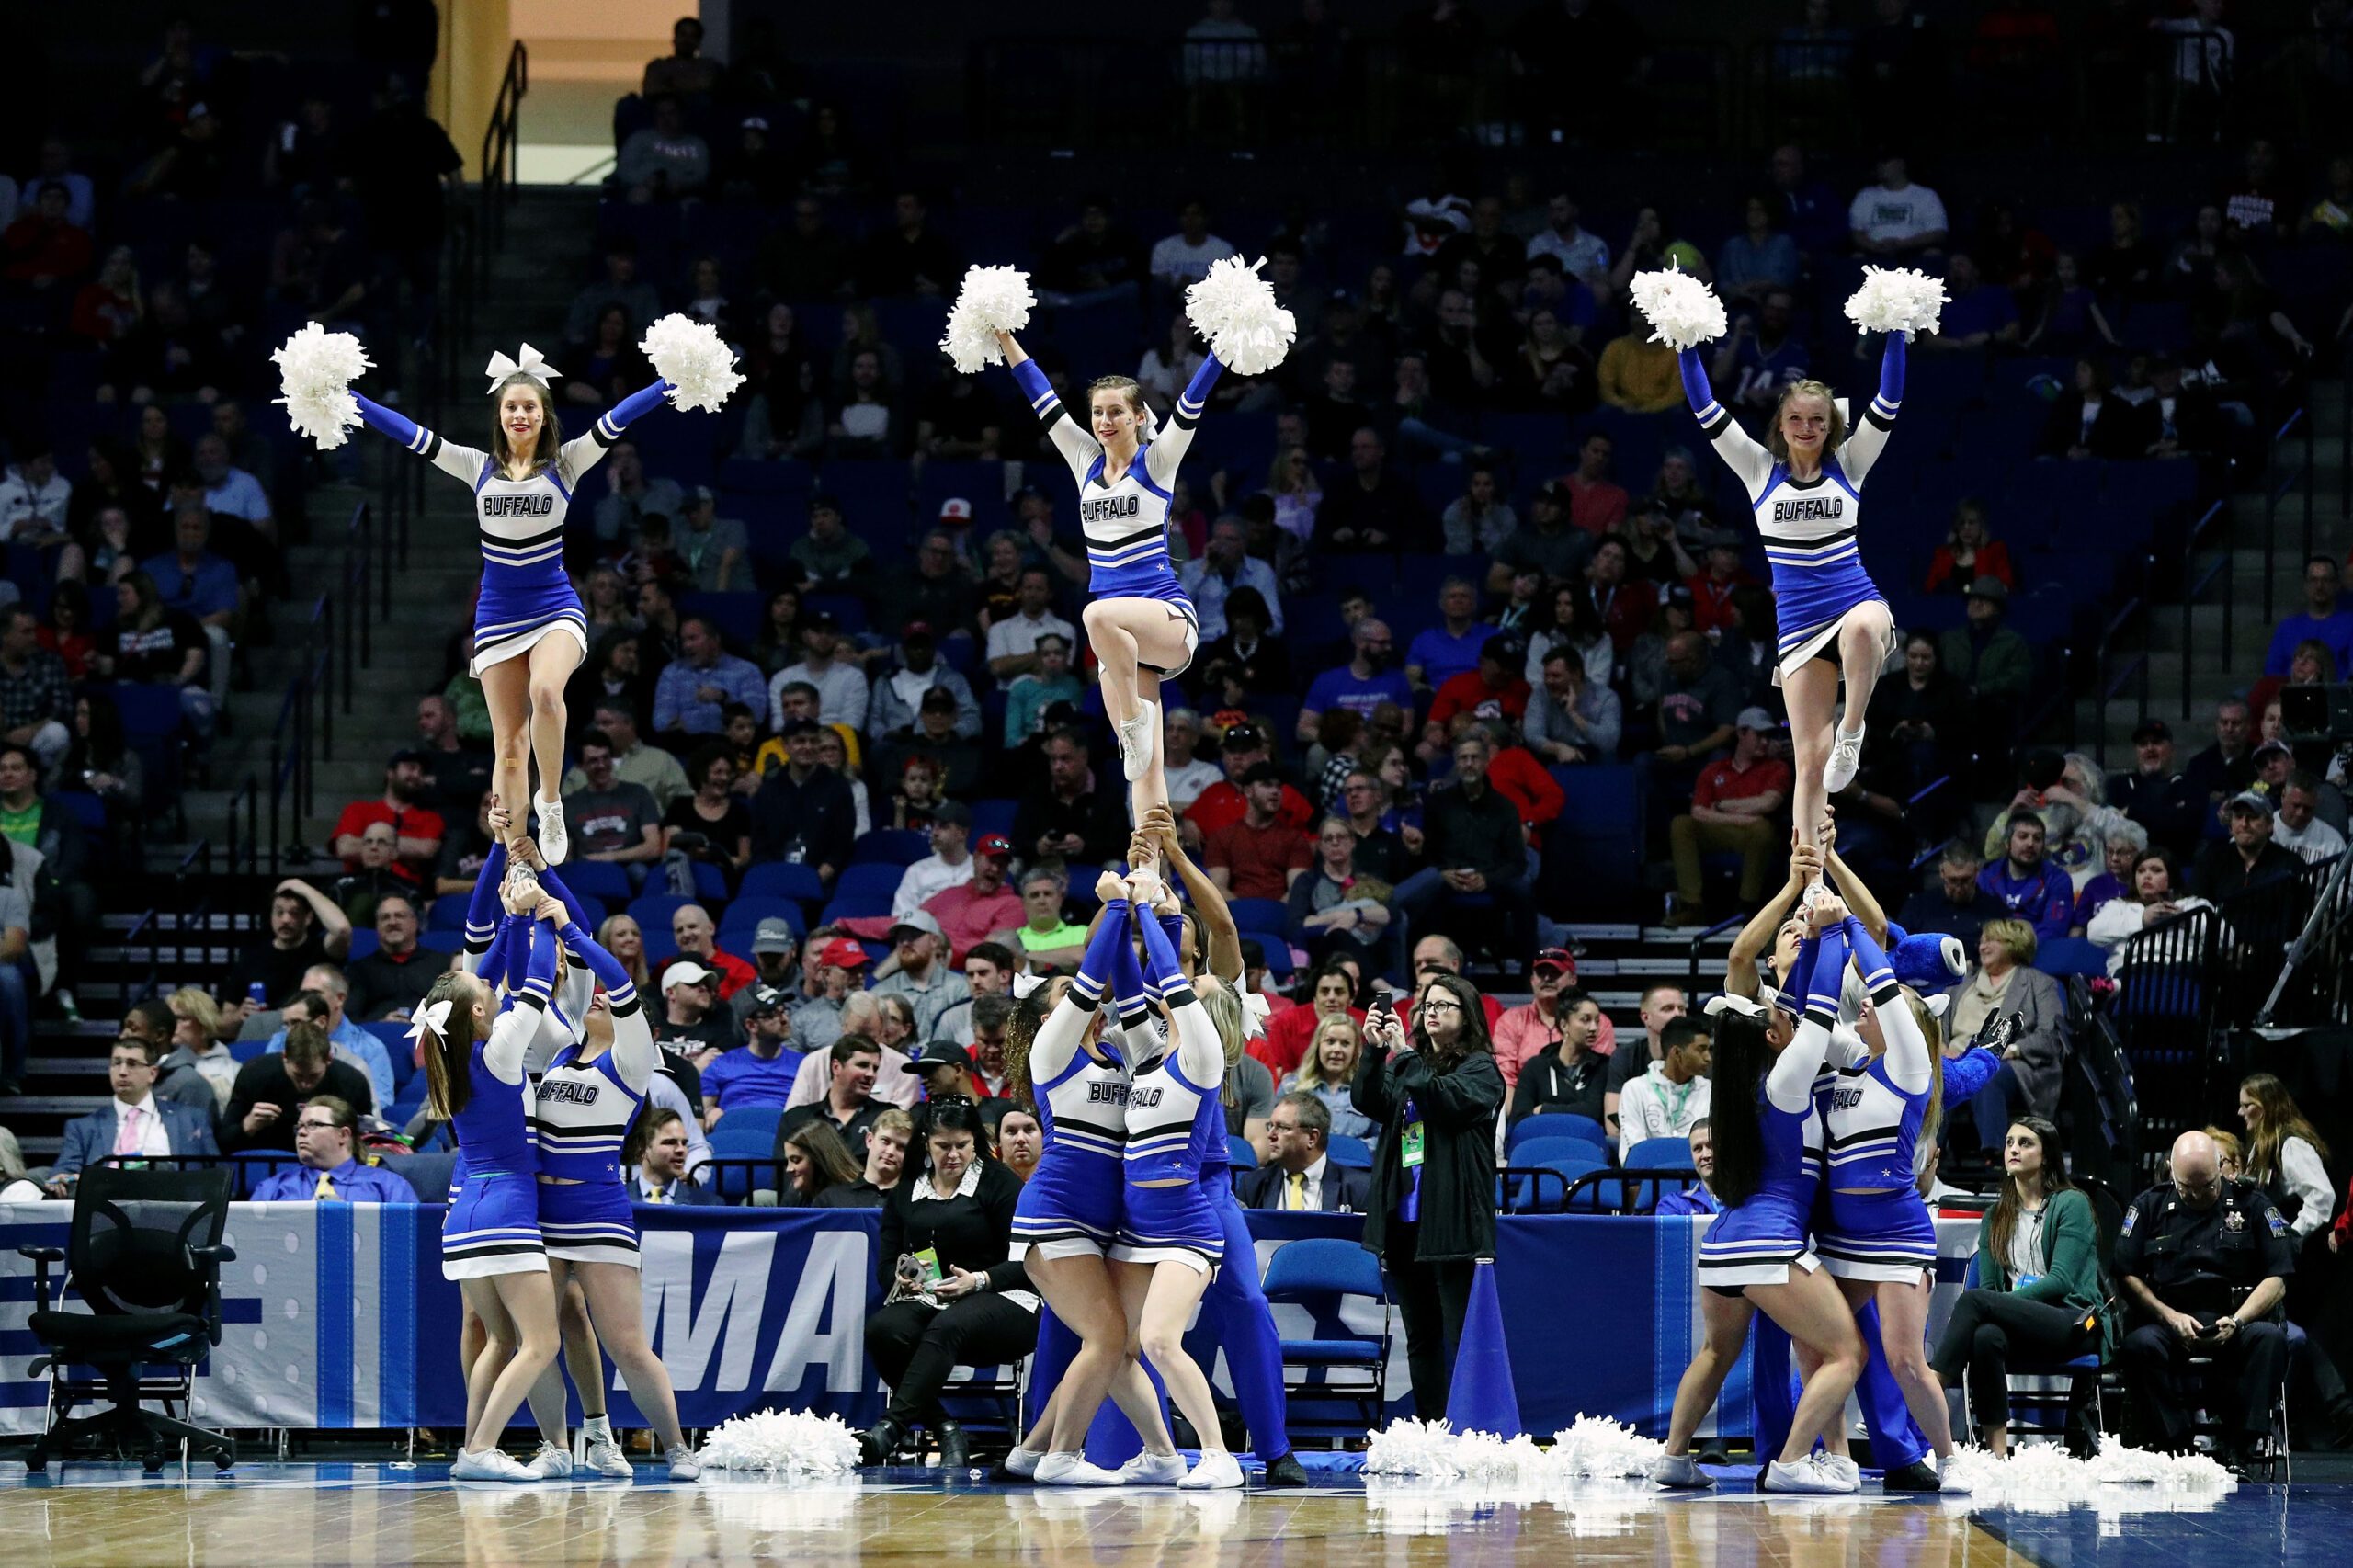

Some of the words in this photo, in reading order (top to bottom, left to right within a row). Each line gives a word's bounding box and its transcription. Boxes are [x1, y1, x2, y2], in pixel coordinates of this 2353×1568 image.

[1733, 365, 1774, 405] 14
[483, 494, 553, 518] BUFFALO
[1082, 494, 1140, 523] BUFFALO
[1773, 496, 1843, 524] BUFFALO
[1831, 1088, 1864, 1113] FALO
